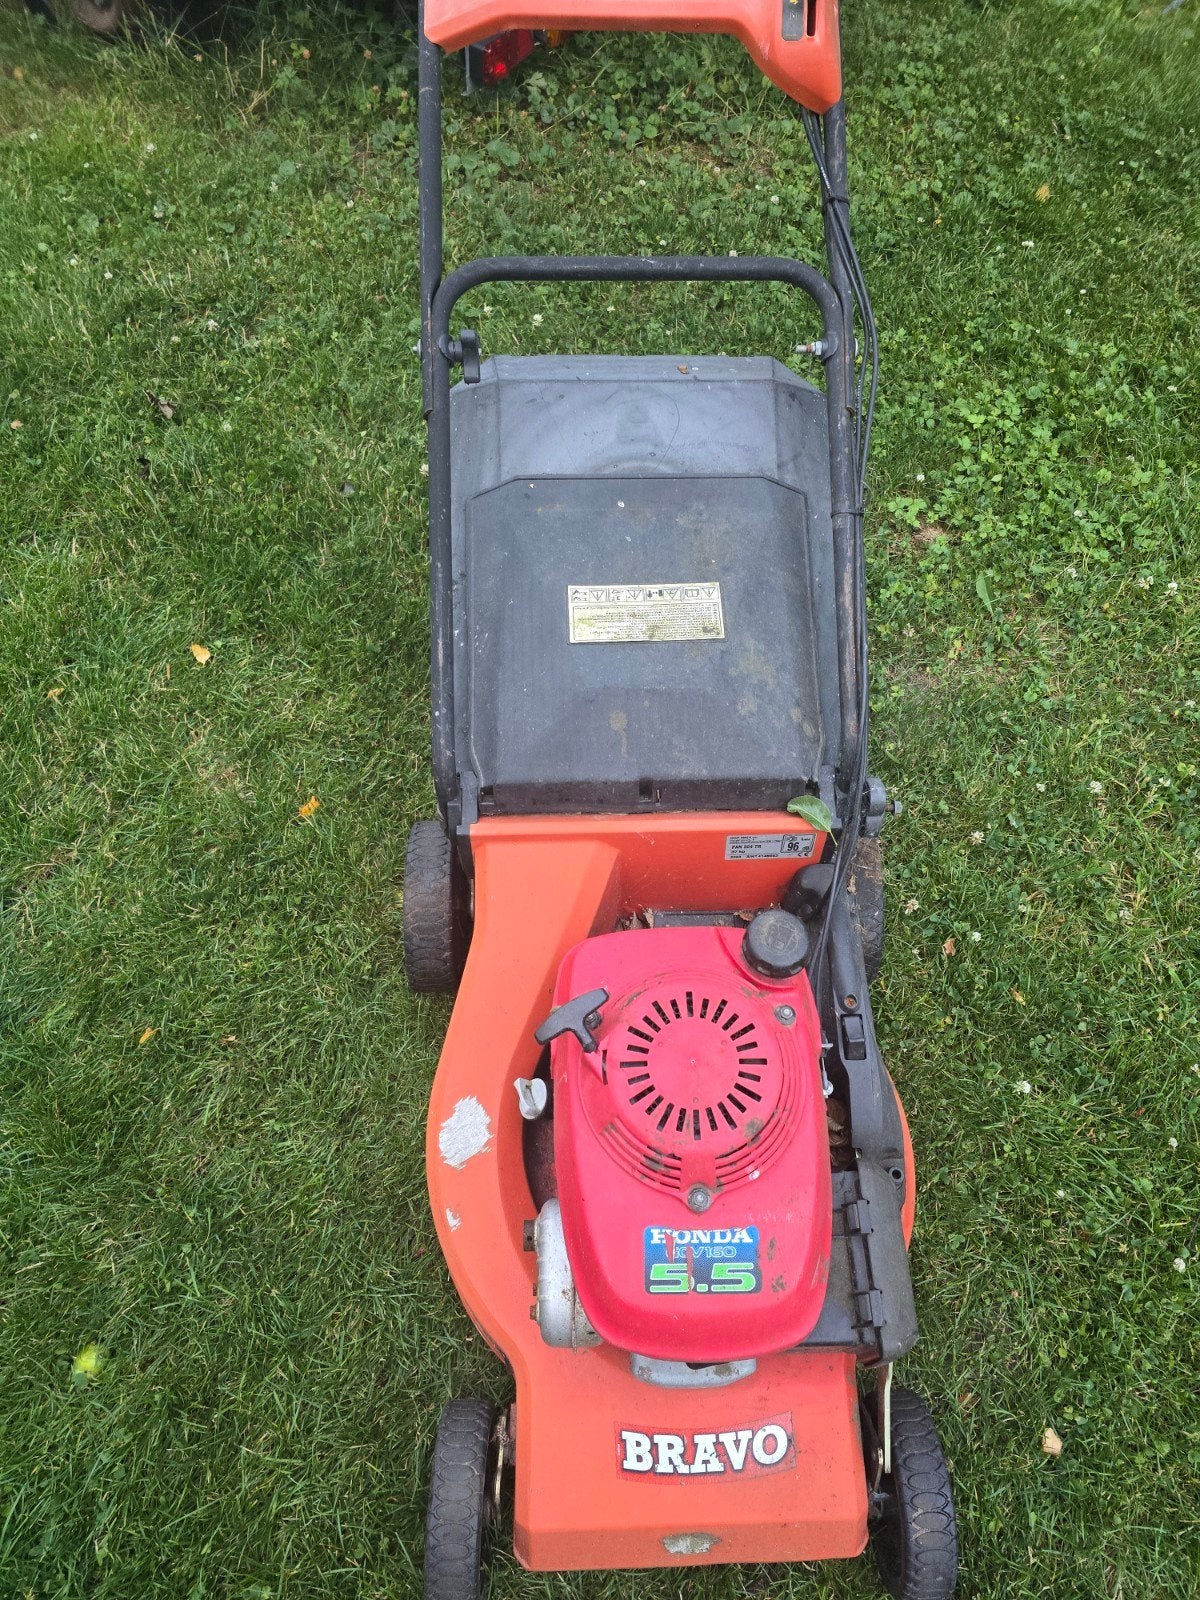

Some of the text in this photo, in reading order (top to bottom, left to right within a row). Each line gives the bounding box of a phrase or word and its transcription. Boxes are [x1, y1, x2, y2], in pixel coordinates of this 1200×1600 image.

[787, 841, 800, 852] 96
[650, 1228, 754, 1245] HONDA
[649, 1262, 757, 1293] 5.5
[621, 1424, 789, 1474] BRAVO
